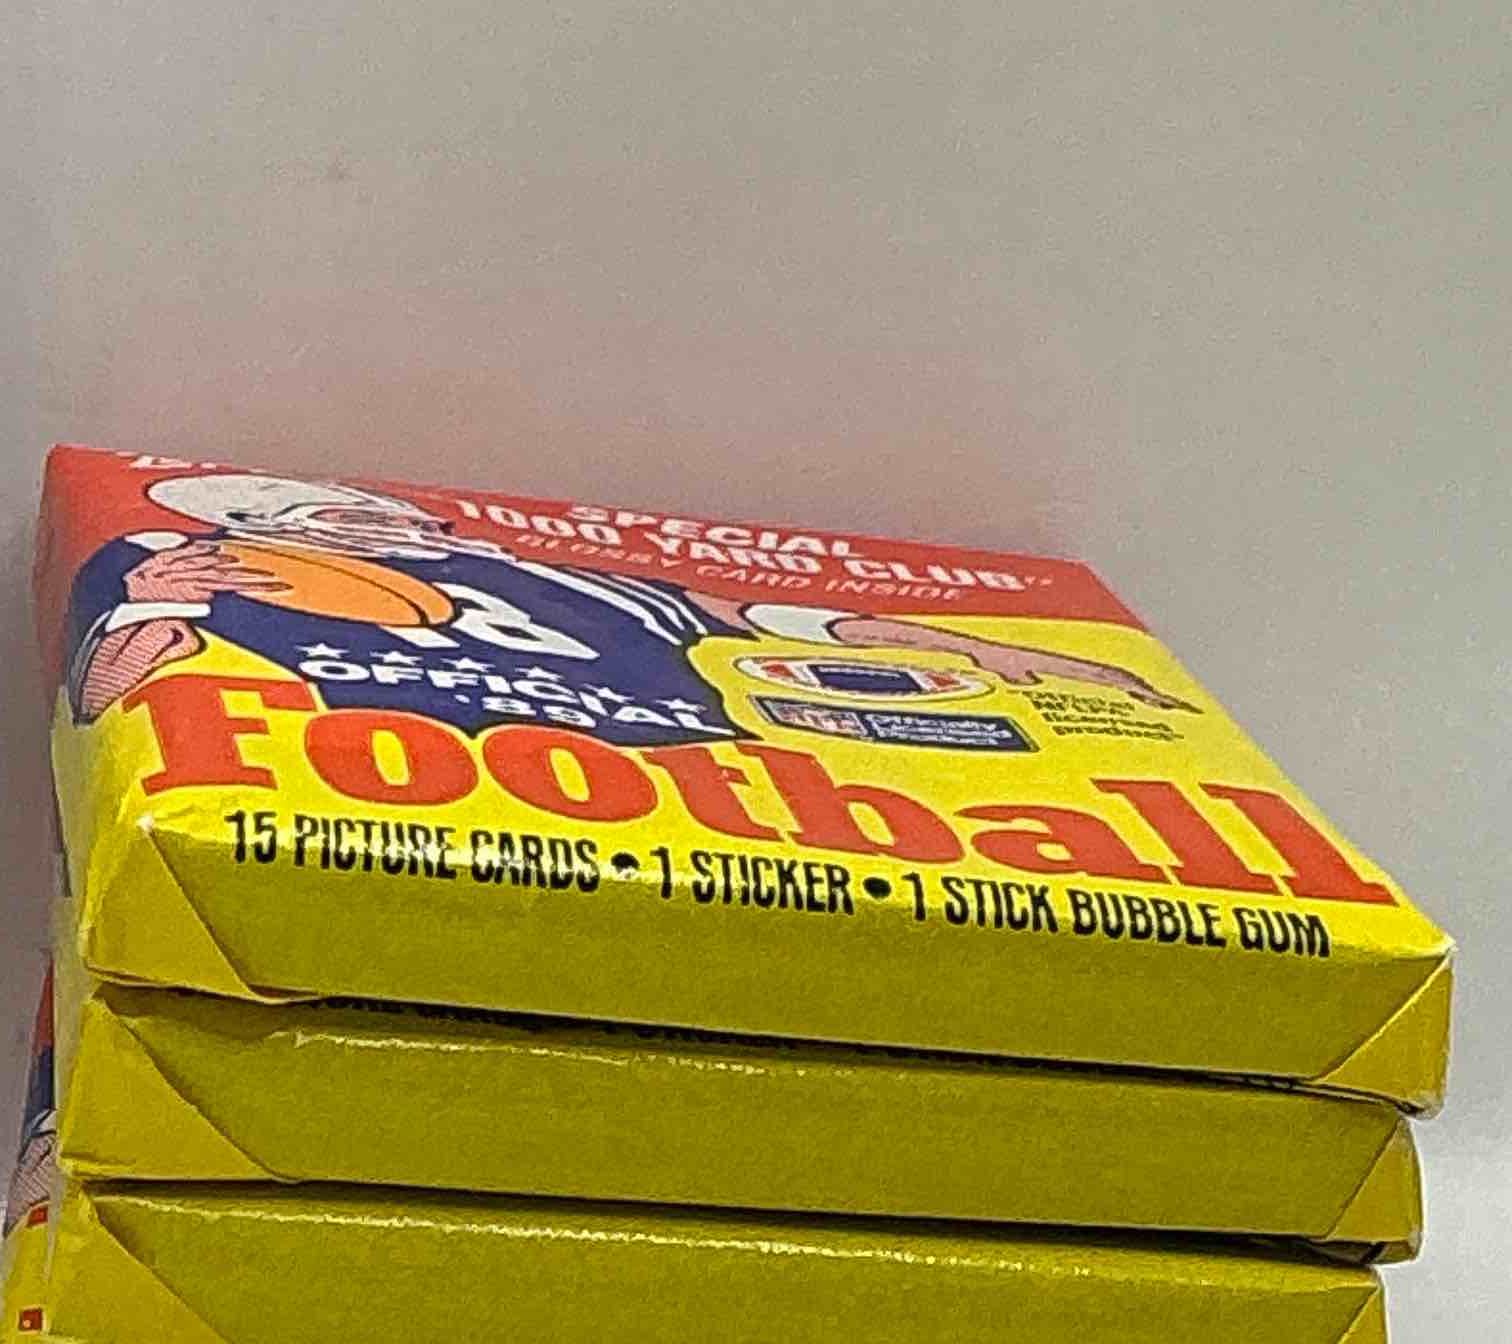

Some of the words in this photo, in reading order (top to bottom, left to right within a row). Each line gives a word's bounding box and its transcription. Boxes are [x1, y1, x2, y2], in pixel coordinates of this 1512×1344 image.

[565, 505, 870, 557] SPECIAL
[643, 531, 821, 574] YARD
[694, 565, 812, 589] CARD
[825, 578, 964, 601] INSIDE
[298, 660, 737, 736] OFFICIAL
[122, 673, 1399, 906] Football
[225, 809, 278, 865] 15
[292, 814, 457, 879] PICTURE
[469, 828, 600, 892] CARDS
[650, 846, 674, 899] 1
[691, 849, 855, 914] STICKER
[903, 871, 928, 922] 1
[943, 877, 1060, 933] STICK
[1069, 888, 1228, 949] BUBBLE
[1240, 909, 1332, 958] GUM
